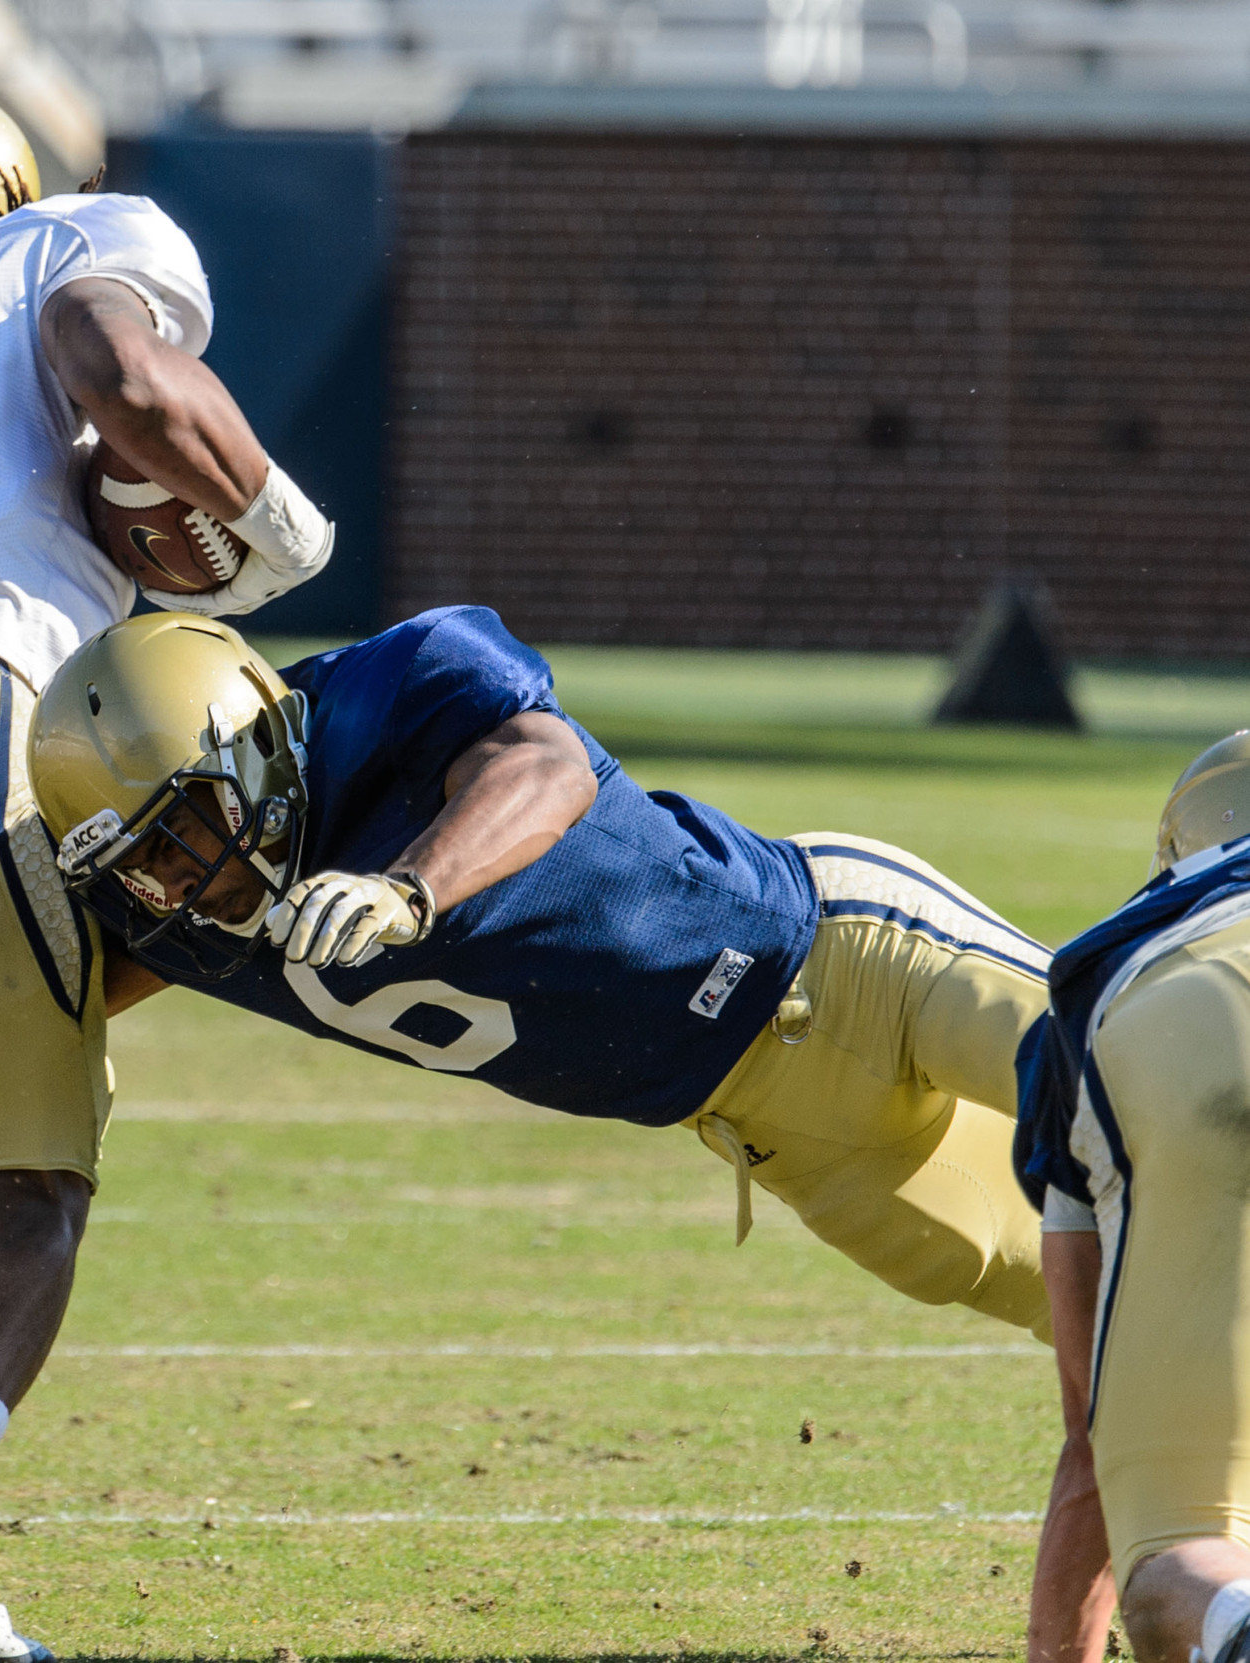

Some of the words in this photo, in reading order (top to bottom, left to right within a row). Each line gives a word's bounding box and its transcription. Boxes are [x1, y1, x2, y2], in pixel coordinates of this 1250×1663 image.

[72, 825, 99, 852] ACC
[124, 878, 174, 908] Riddell
[720, 962, 739, 979] XL
[283, 942, 517, 1072] 6
